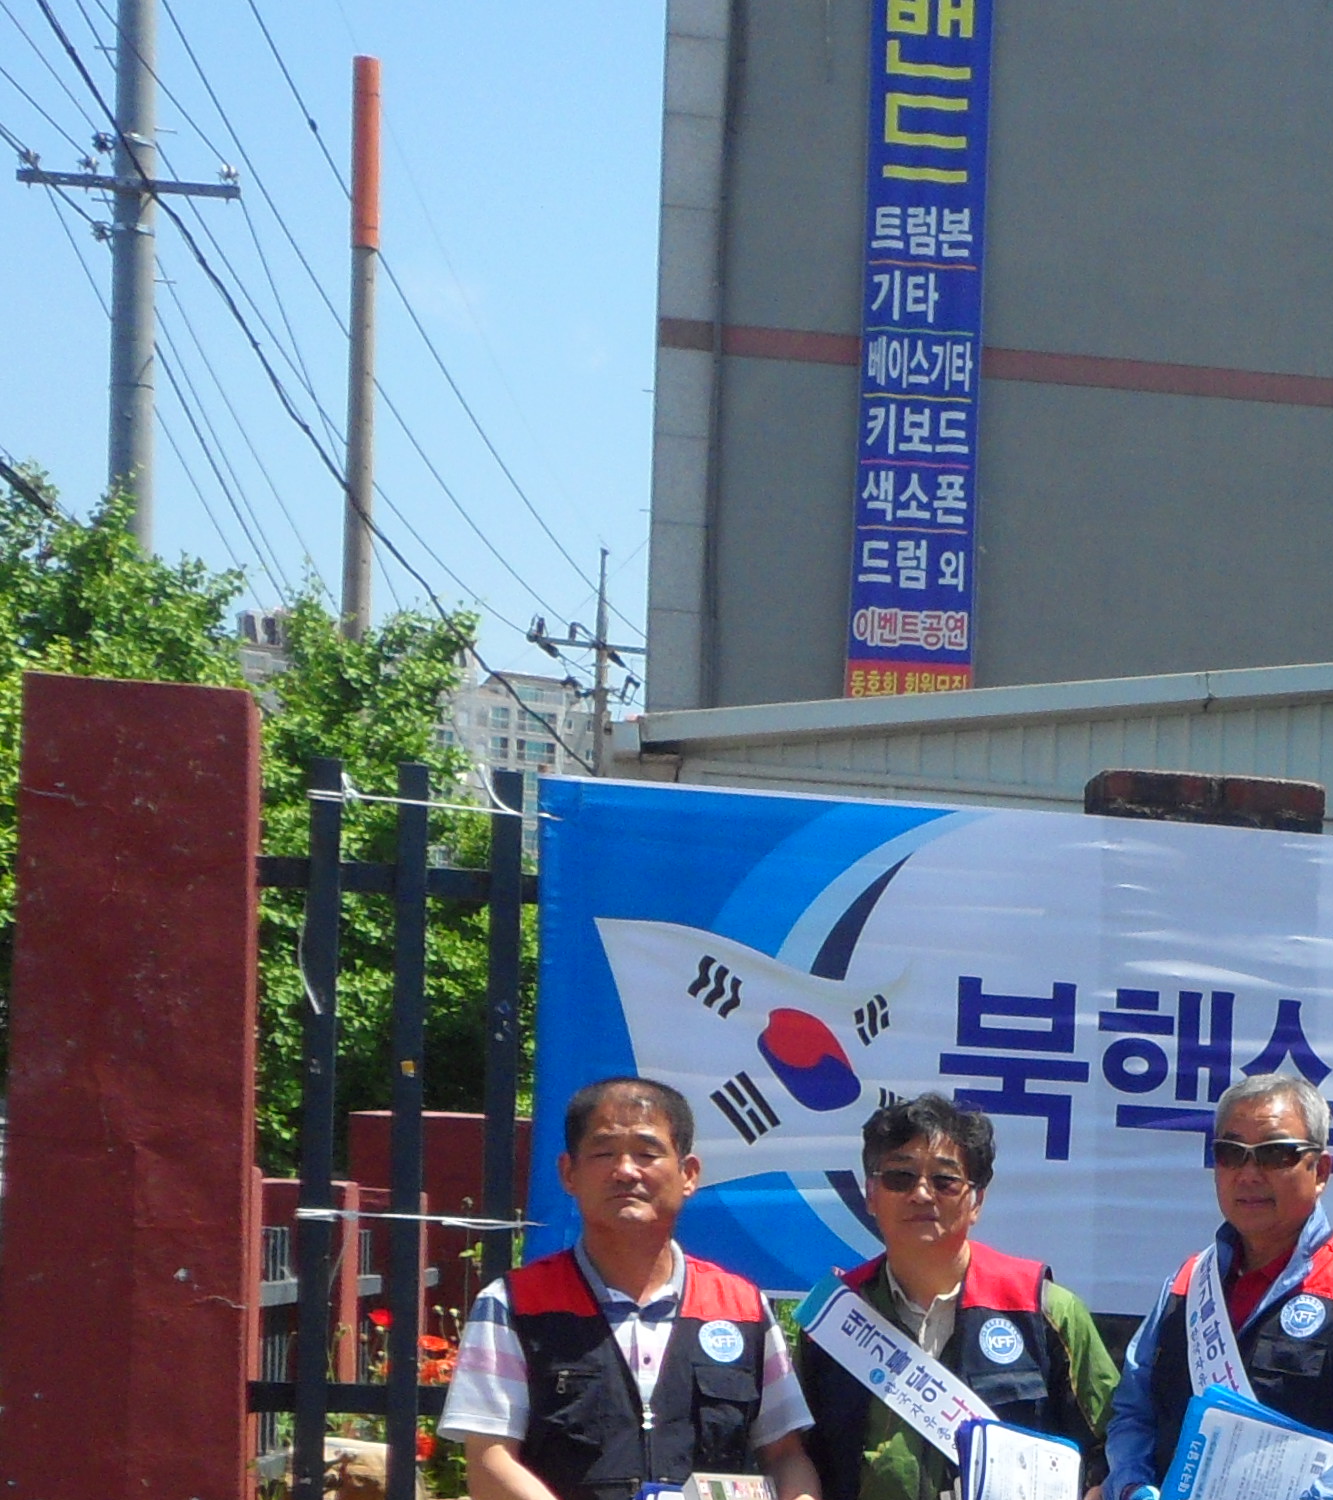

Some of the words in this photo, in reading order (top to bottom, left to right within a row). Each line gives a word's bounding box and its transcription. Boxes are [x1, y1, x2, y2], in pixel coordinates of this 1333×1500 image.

[871, 206, 973, 258] 트럼본
[871, 270, 939, 323] 기타
[867, 335, 973, 392] 베이스기타
[865, 403, 970, 455] 키보드
[861, 470, 968, 525] 색소폰
[857, 539, 928, 590] 드럼
[937, 550, 965, 592] 외
[854, 607, 969, 650] 이벤트공연
[850, 670, 898, 698] 동호회
[988, 1335, 1016, 1350] KFF
[1292, 1309, 1317, 1324] KFF
[840, 1307, 913, 1377] 태극기를
[905, 1364, 948, 1403] 달아
